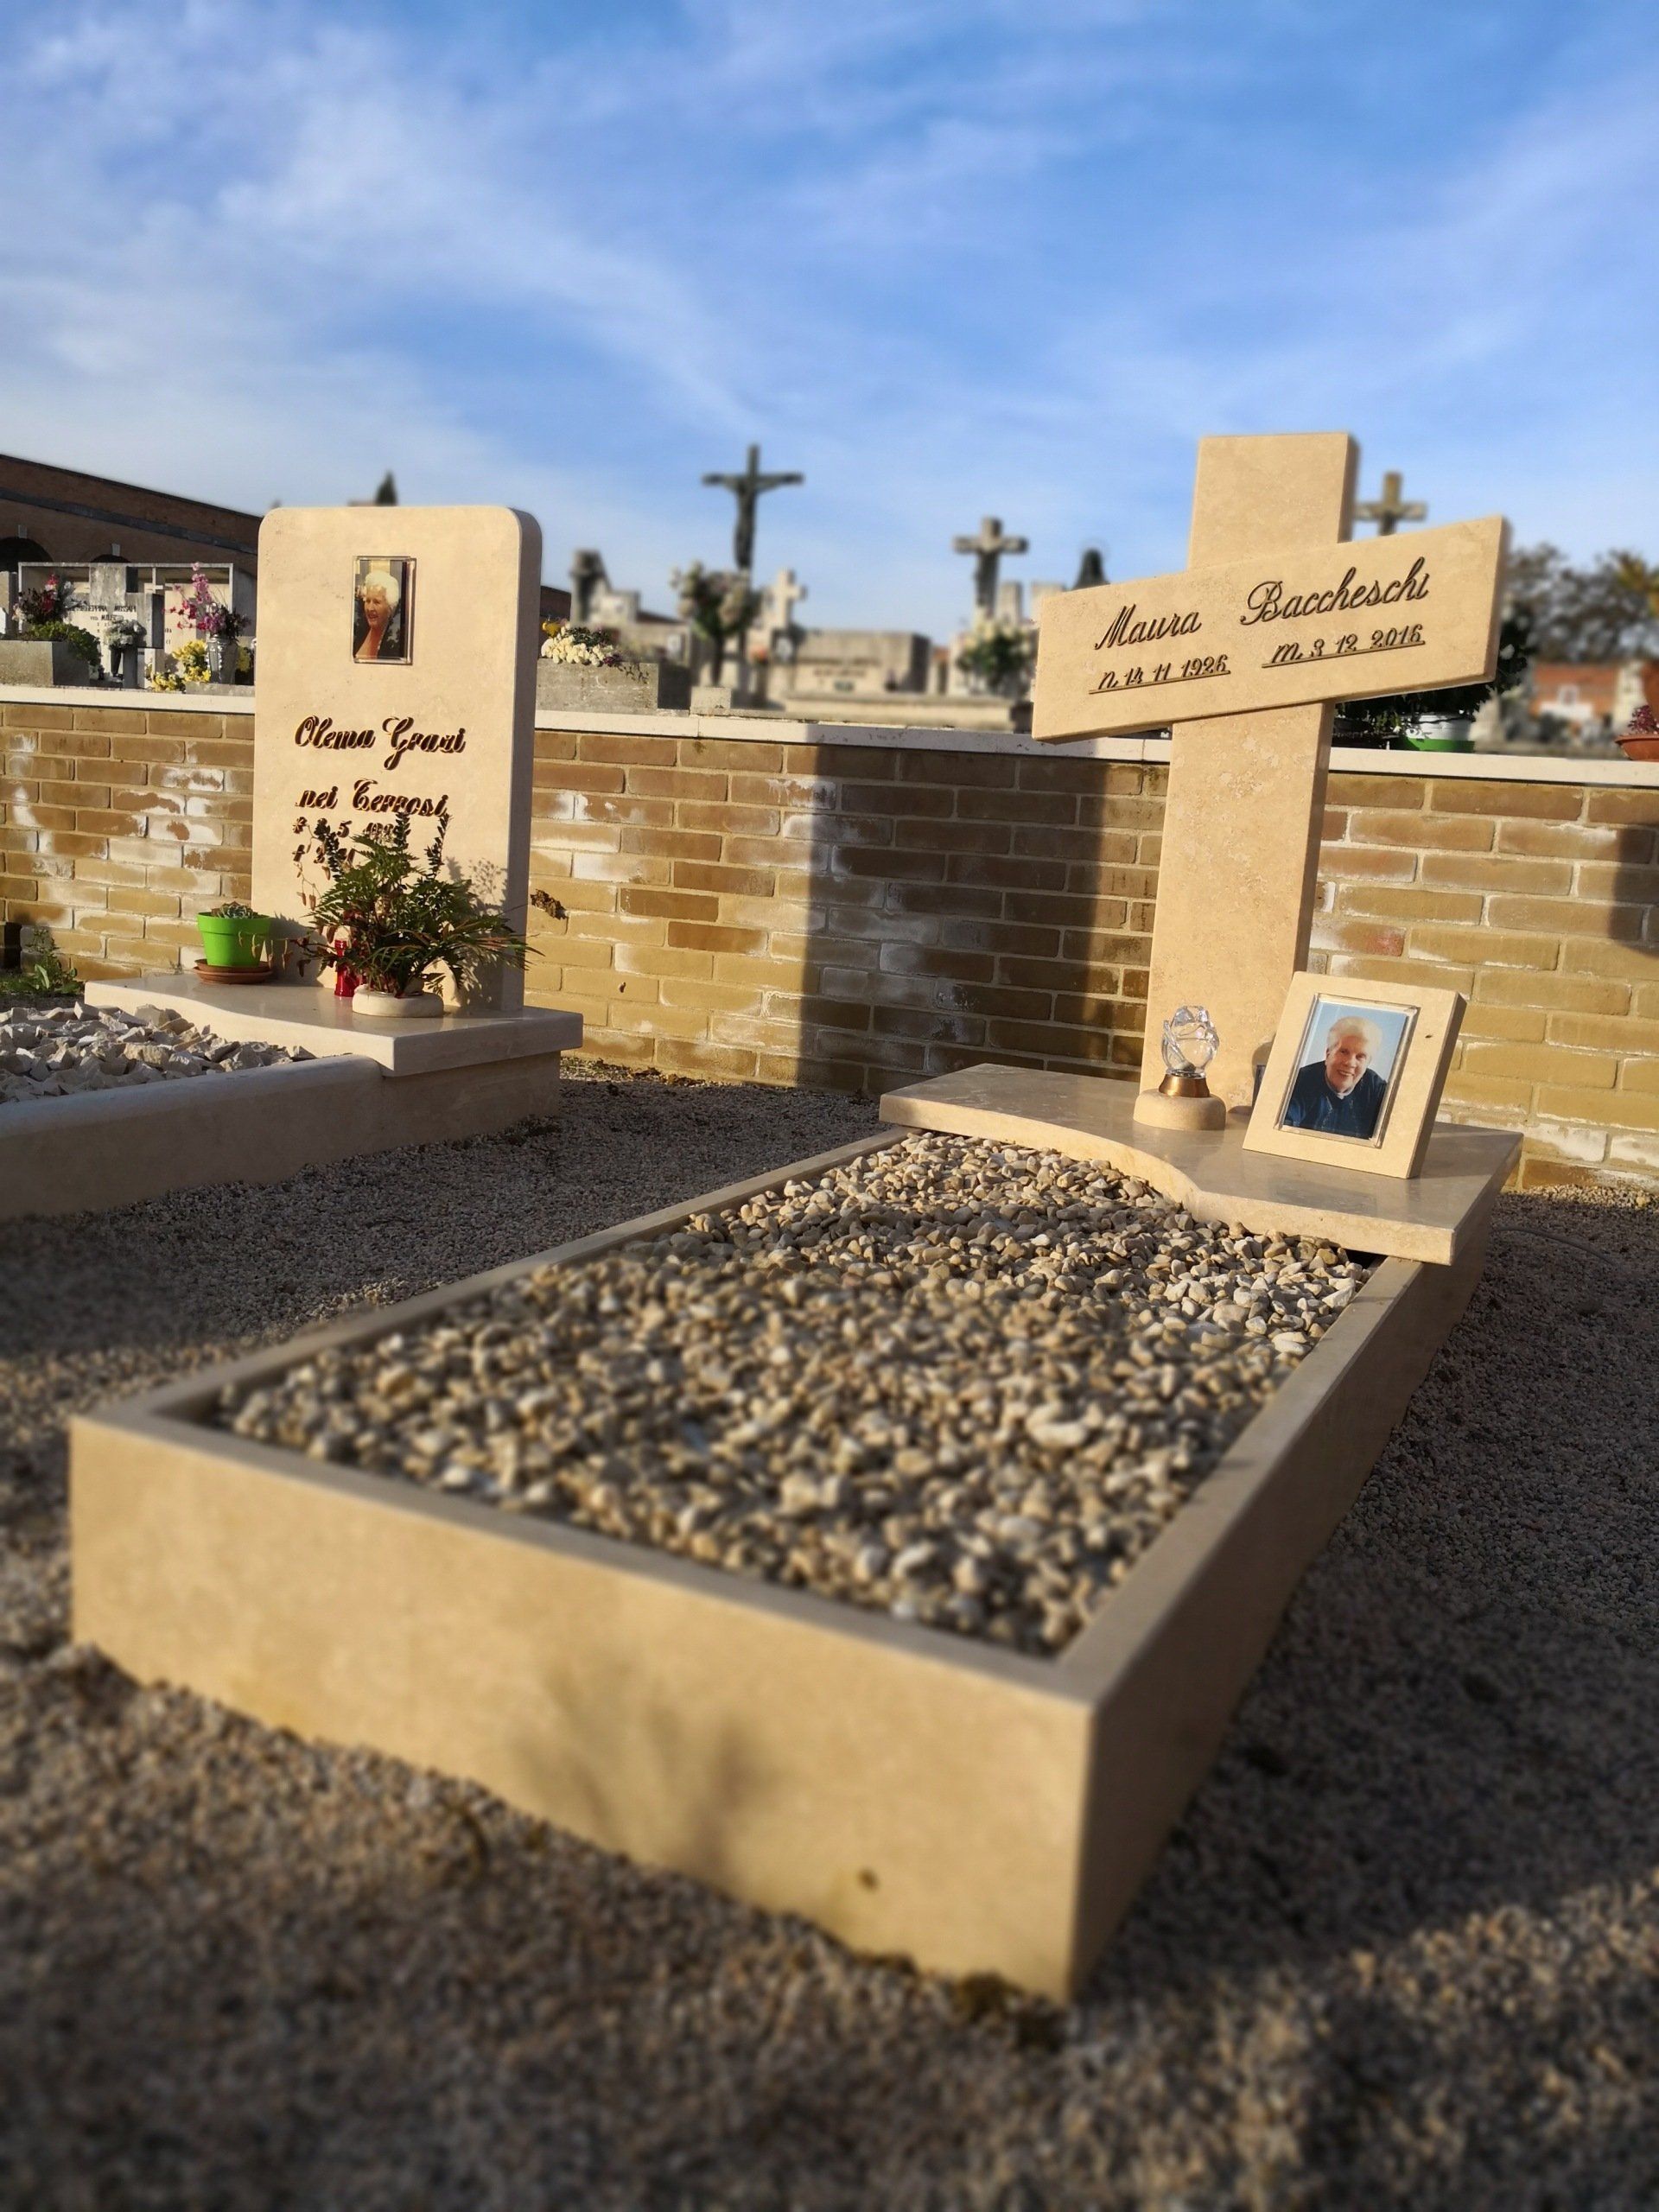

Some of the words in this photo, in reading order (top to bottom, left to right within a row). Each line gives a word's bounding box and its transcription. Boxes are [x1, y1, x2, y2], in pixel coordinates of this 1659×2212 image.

[1095, 604, 1202, 650] Maura
[1240, 556, 1430, 626] Baccheschi
[1153, 663, 1172, 682] 11
[1180, 654, 1229, 678] 1926
[1310, 639, 1325, 657] 3
[1336, 633, 1358, 654] 12
[1370, 624, 1424, 649] 2016
[295, 715, 376, 750] Olema
[295, 785, 339, 810] nei
[352, 778, 449, 817] Terrosi
[337, 820, 353, 838] 5
